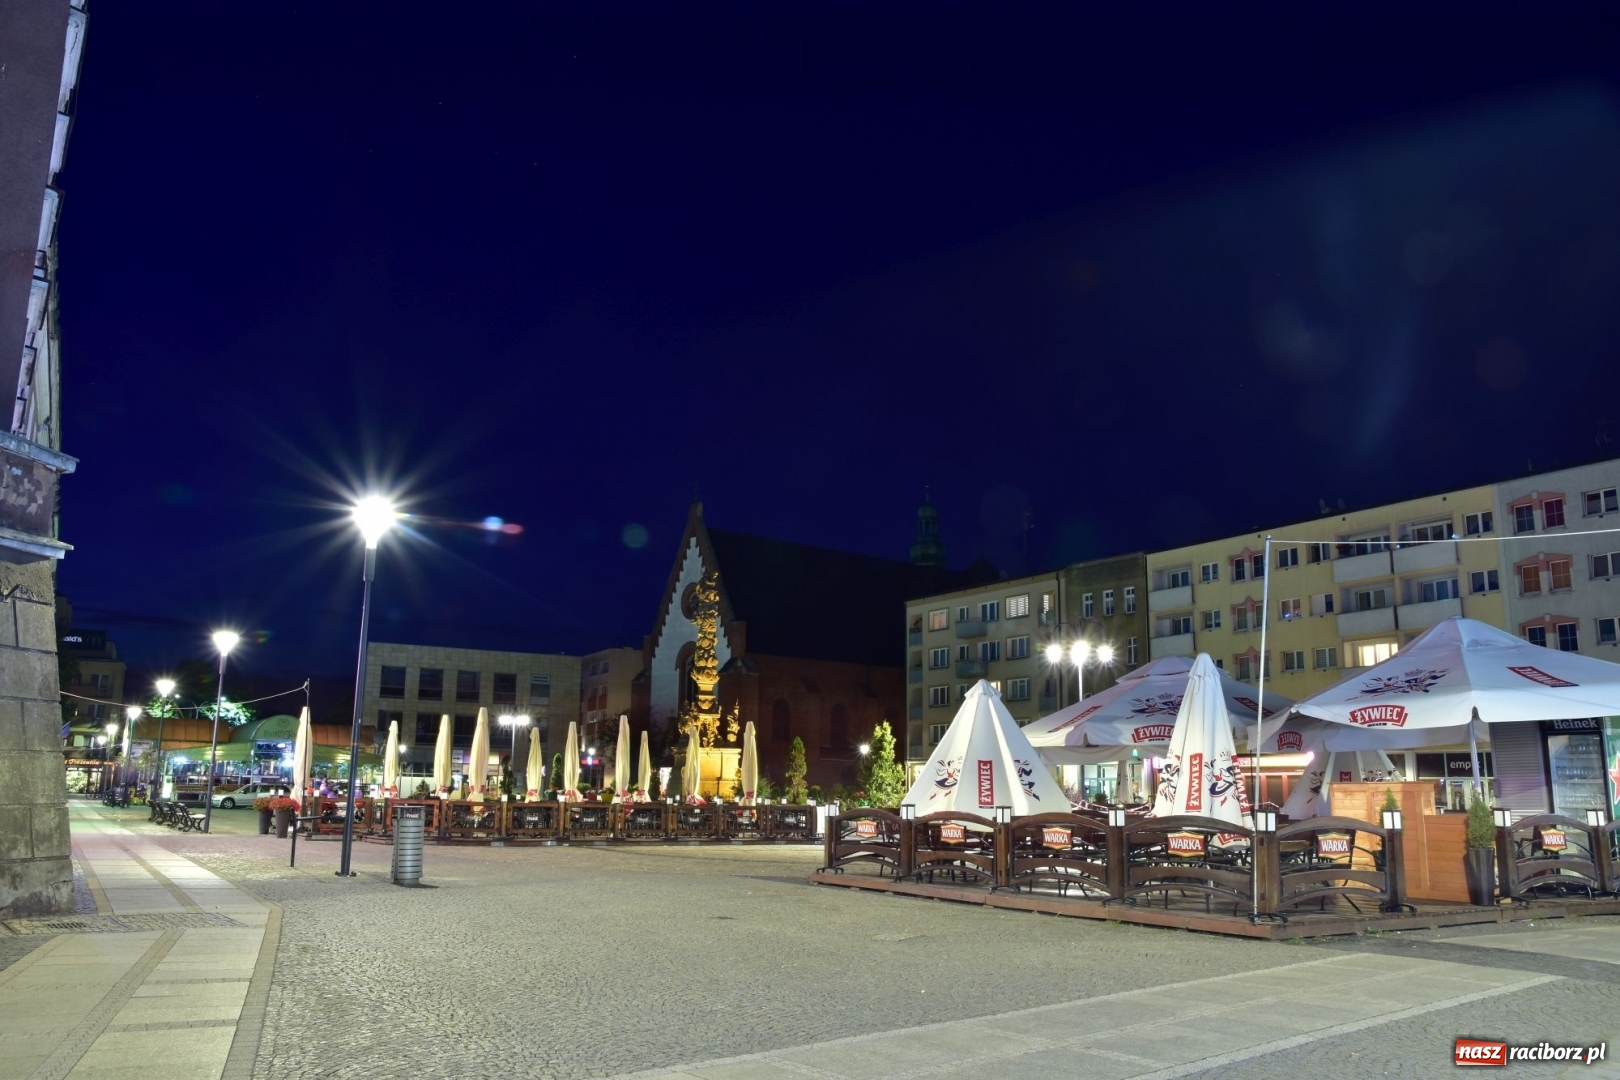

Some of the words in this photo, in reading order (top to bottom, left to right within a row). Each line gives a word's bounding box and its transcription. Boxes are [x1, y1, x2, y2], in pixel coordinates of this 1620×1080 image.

[1354, 706, 1401, 724] ŻYWIEC
[1553, 719, 1598, 730] Heinek
[1450, 761, 1480, 770] emp
[980, 762, 992, 803] ŻYWIEC
[1189, 756, 1200, 807] ŻYWIEC
[857, 824, 875, 833] WARKA
[941, 829, 962, 838] WARKA
[1044, 832, 1069, 843] WARKA
[1544, 834, 1565, 845] WARKA
[1169, 838, 1202, 850] WARKA
[1321, 838, 1349, 852] WARKA
